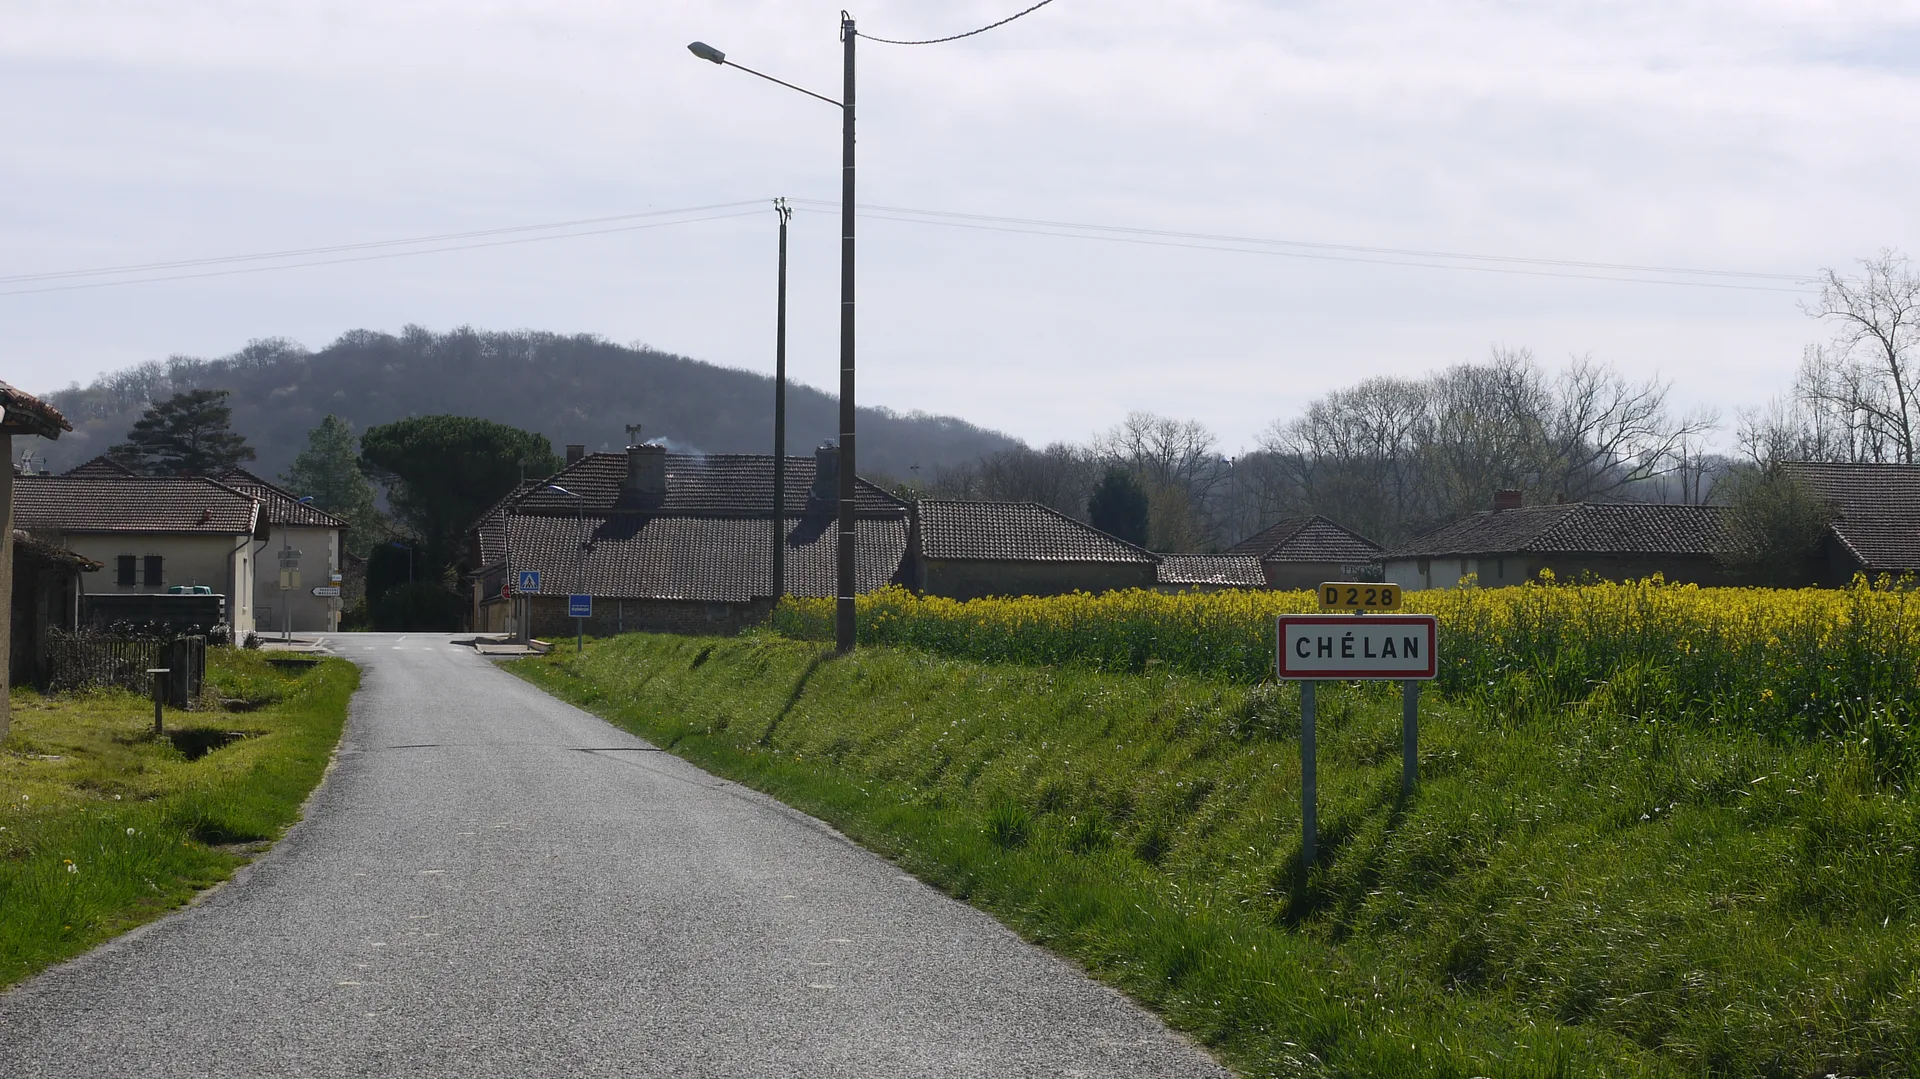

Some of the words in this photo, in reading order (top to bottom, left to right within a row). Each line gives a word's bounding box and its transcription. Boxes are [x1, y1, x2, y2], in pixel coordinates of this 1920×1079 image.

[1326, 588, 1338, 605] D
[1347, 588, 1393, 606] 228
[1296, 632, 1418, 659] CHÉLAN
